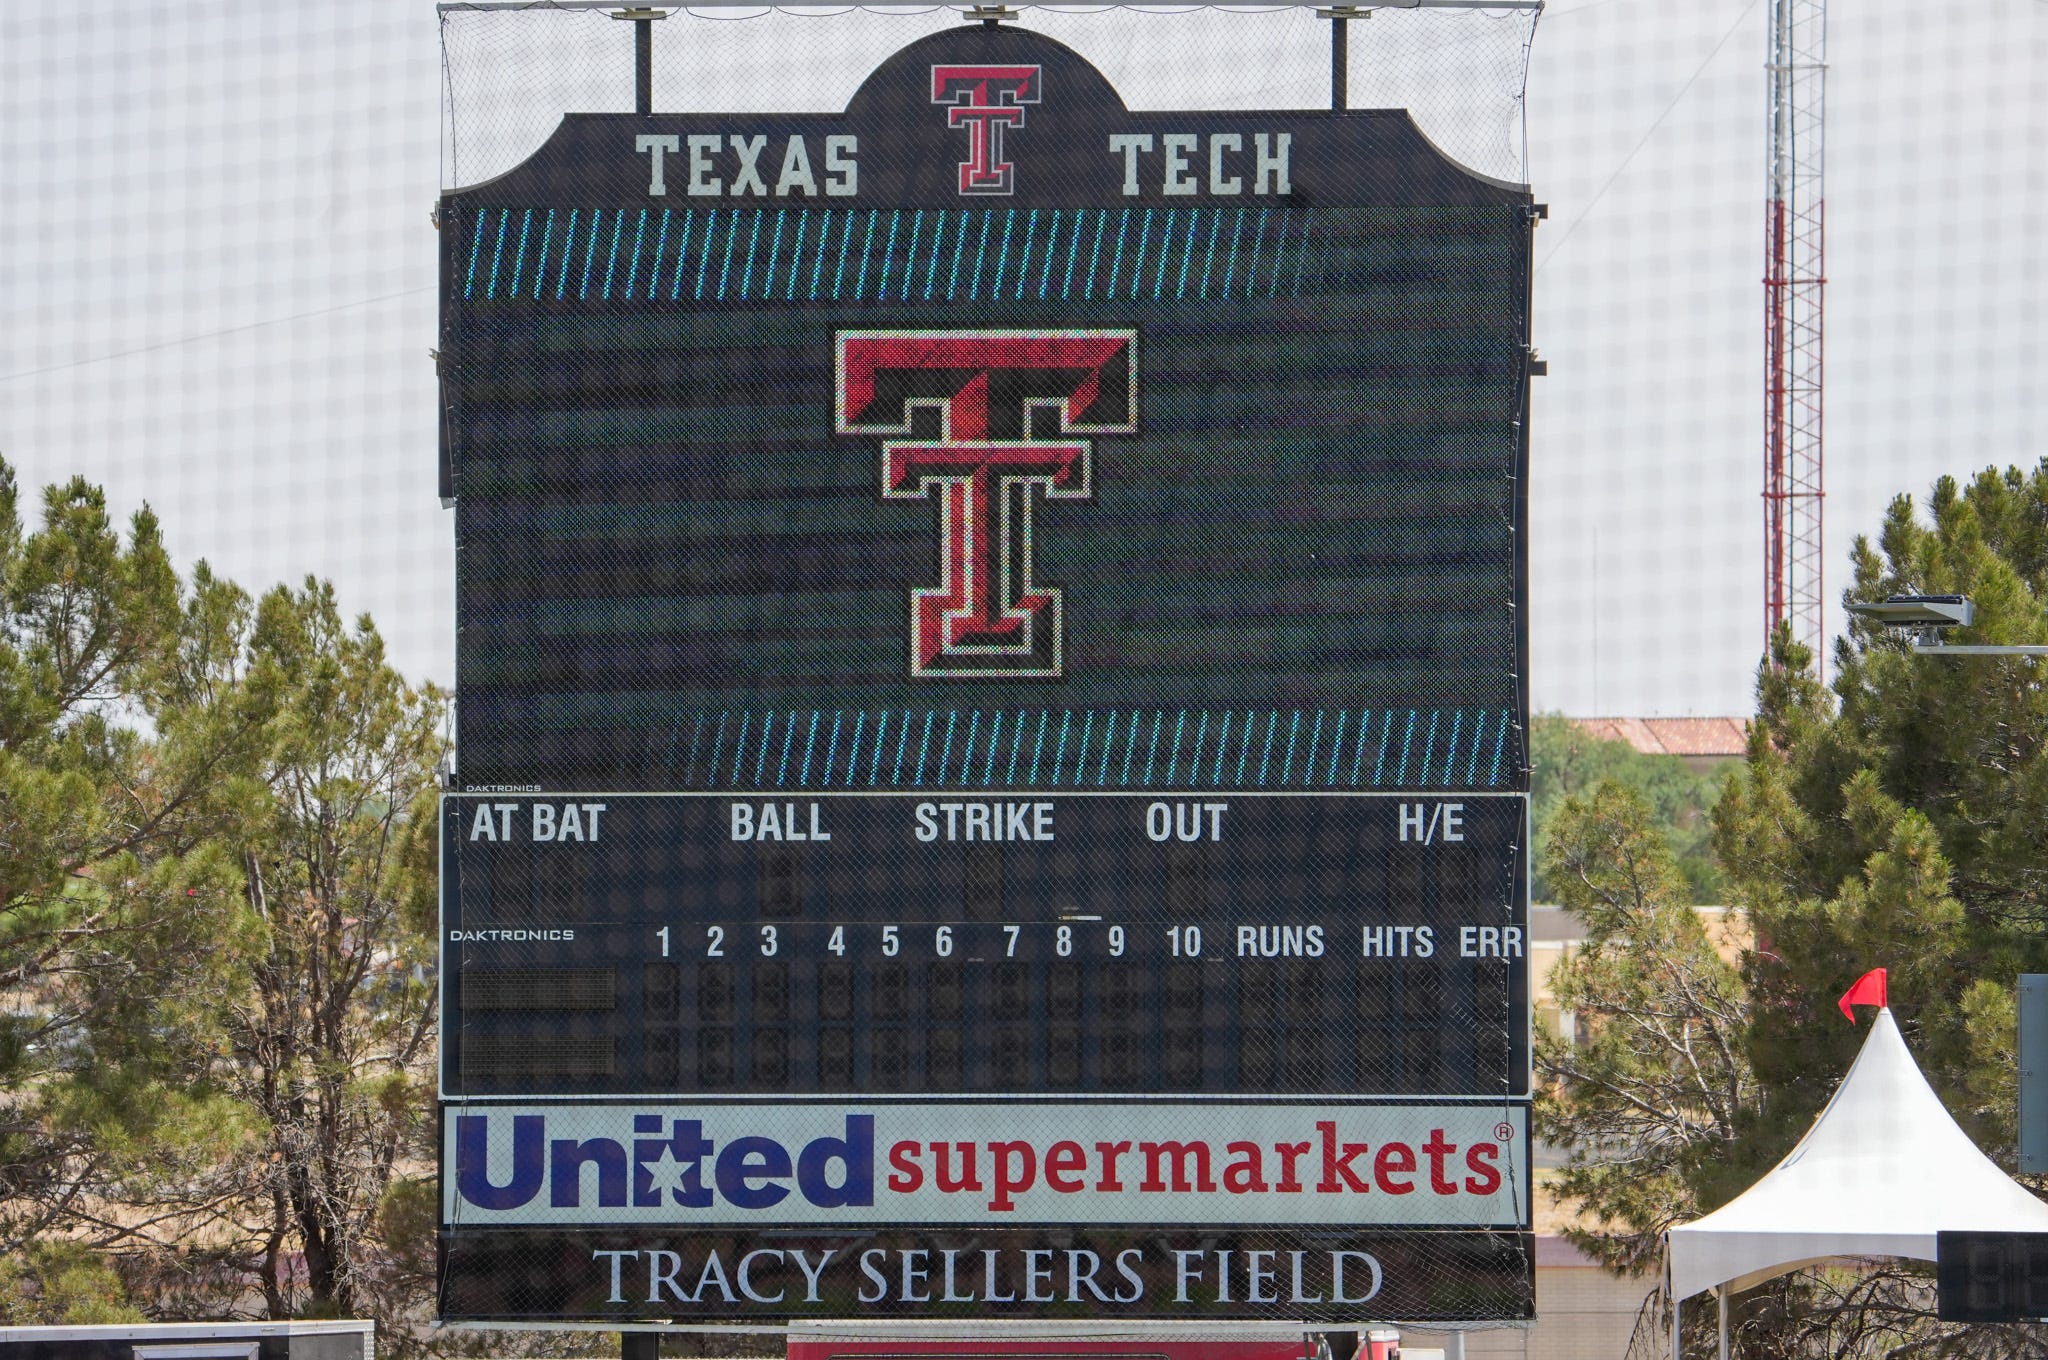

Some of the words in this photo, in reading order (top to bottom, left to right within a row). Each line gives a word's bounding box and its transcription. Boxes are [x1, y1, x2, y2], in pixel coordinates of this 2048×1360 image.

[635, 134, 859, 197] TEXAS
[1109, 132, 1293, 197] TECH
[466, 784, 542, 793] DAKTRONICS
[469, 803, 519, 842] AT
[532, 803, 607, 842] BAT
[731, 802, 832, 842] BALL
[914, 801, 1055, 842] STRIKE
[1145, 801, 1228, 842] OUT
[1399, 802, 1464, 846] H/E
[449, 929, 575, 942] DAKTRONICS
[656, 925, 670, 958] 1
[706, 925, 725, 958] 2
[760, 925, 778, 958] 3
[827, 925, 846, 958] 4
[881, 925, 900, 958] 5
[935, 925, 953, 958] 6
[1003, 925, 1021, 958] 7
[1055, 925, 1073, 958] 8
[1108, 925, 1125, 958] 9
[1166, 925, 1201, 958] 10
[1237, 925, 1325, 958] RUNS
[1362, 925, 1435, 958] HITS
[1459, 925, 1523, 958] ERR
[455, 1113, 875, 1211] United
[592, 1248, 839, 1303] TRACY
[857, 1247, 1144, 1303] SELLERS
[1170, 1249, 1384, 1304] FIELD
